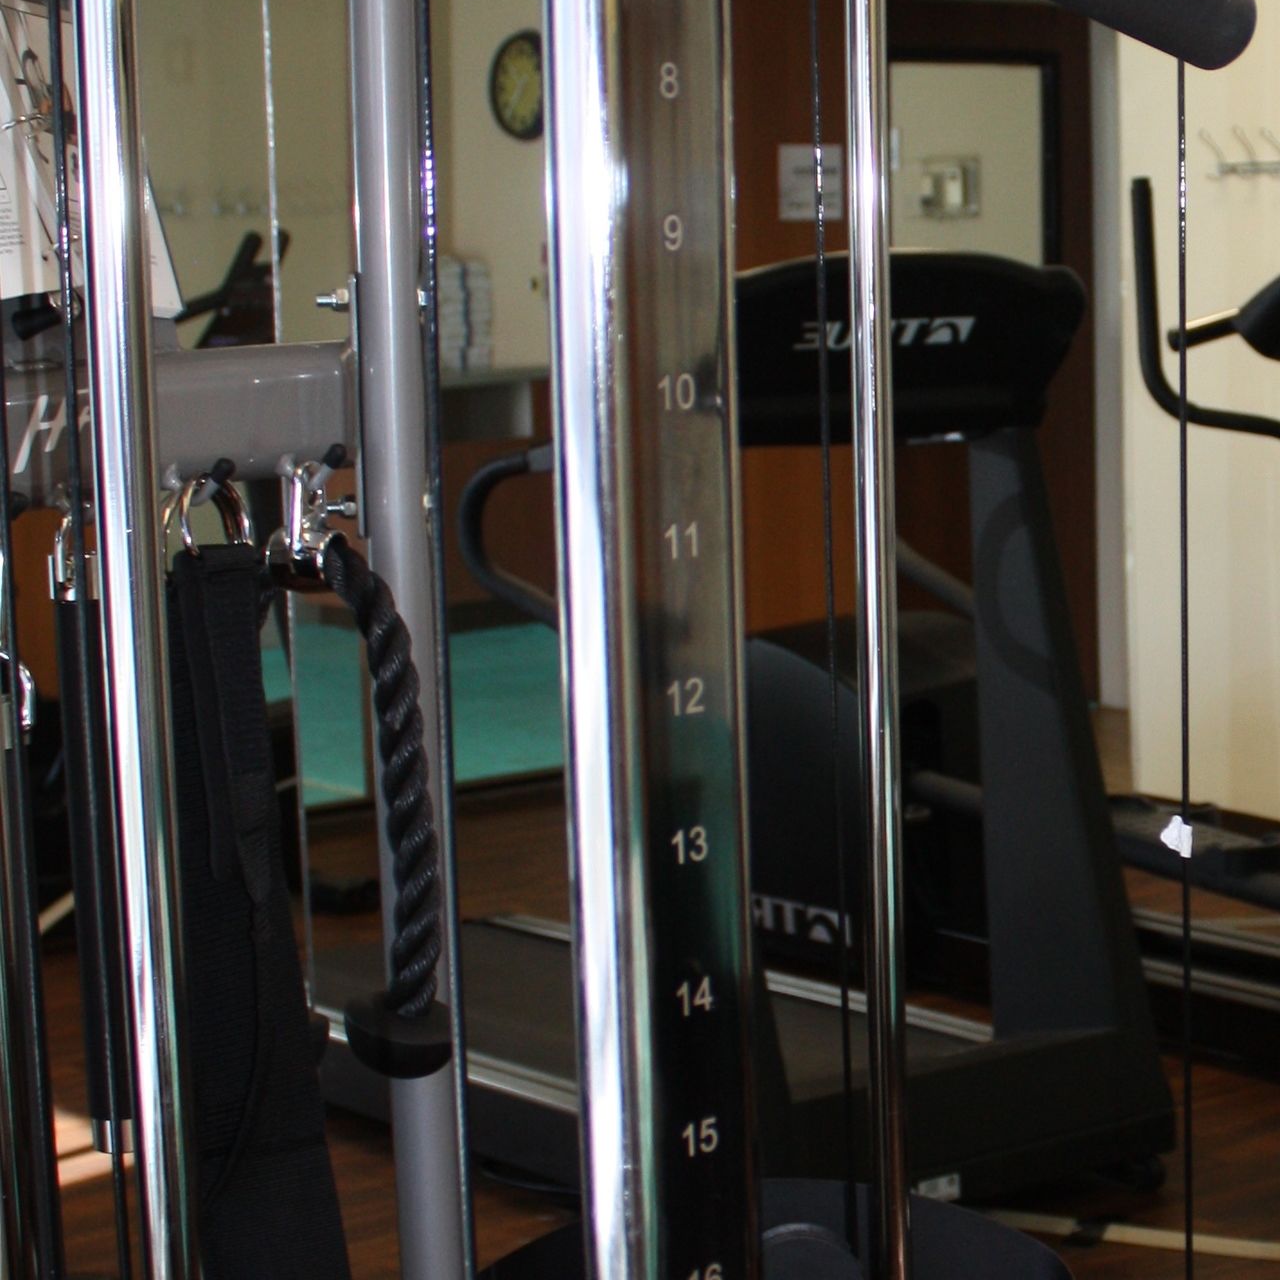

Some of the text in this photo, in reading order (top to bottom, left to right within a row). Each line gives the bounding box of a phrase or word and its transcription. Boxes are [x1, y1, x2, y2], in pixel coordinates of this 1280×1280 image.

[659, 61, 679, 99] 8
[663, 214, 683, 251] 9
[657, 373, 696, 410] 10
[664, 521, 698, 560] 11
[667, 677, 704, 716] 12
[671, 825, 708, 865] 13
[676, 976, 713, 1017] 14
[682, 1116, 718, 1157] 15
